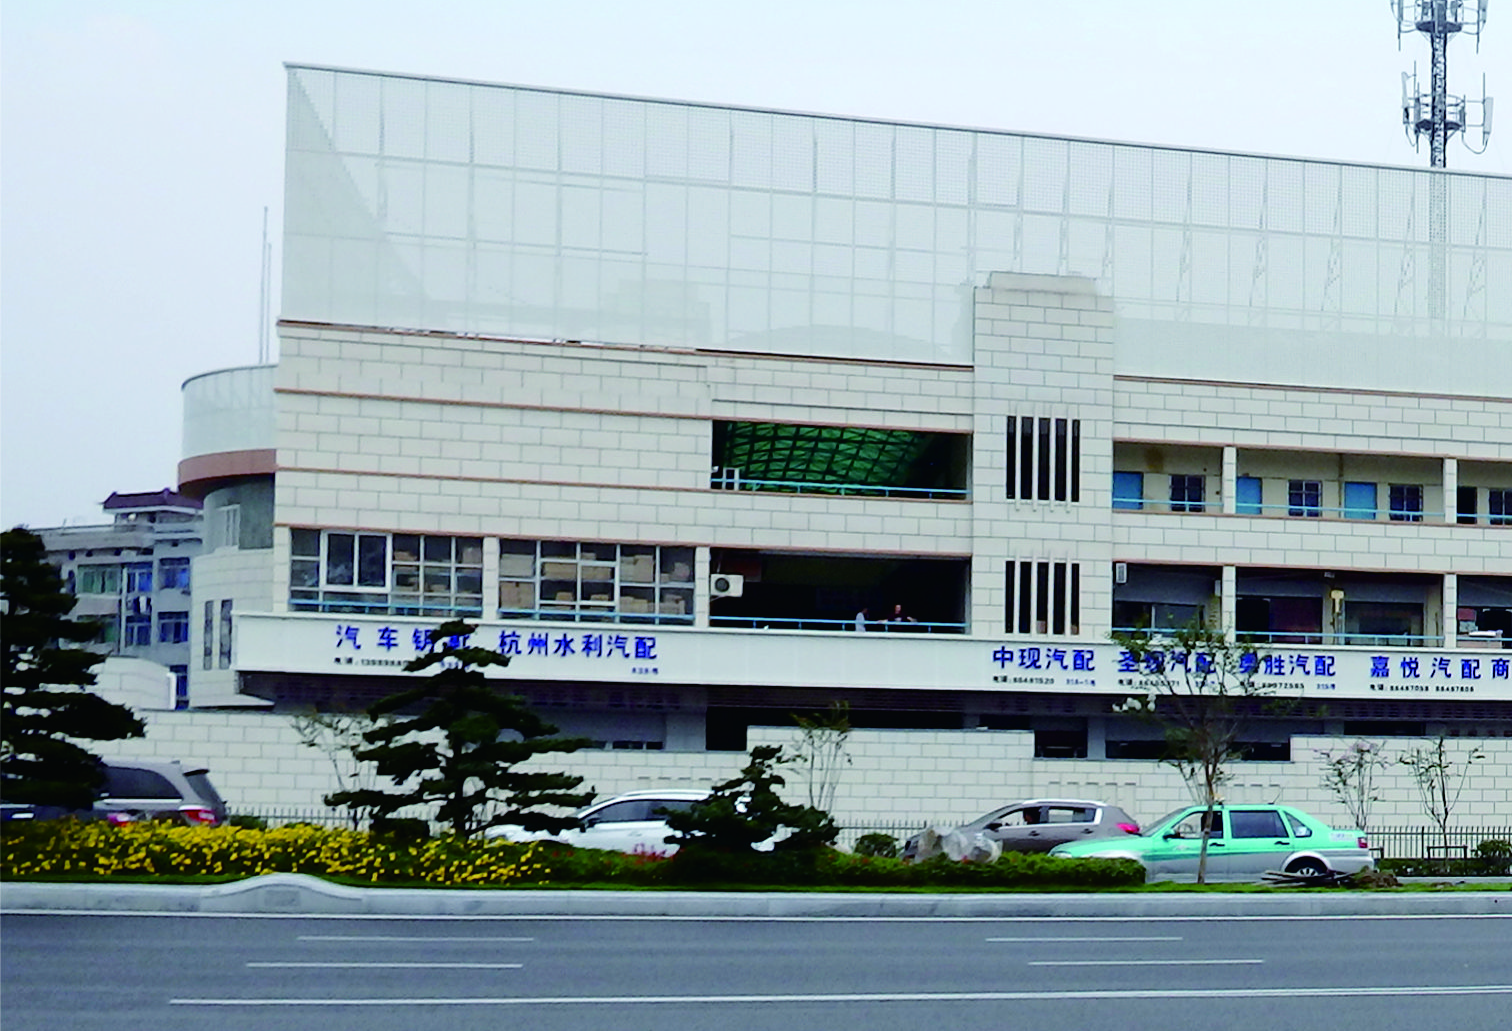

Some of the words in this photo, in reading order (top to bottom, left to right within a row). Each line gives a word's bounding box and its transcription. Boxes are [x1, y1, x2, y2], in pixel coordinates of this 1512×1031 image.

[499, 629, 657, 659] 杭州水利汽配
[993, 645, 1096, 671] 中现汽配
